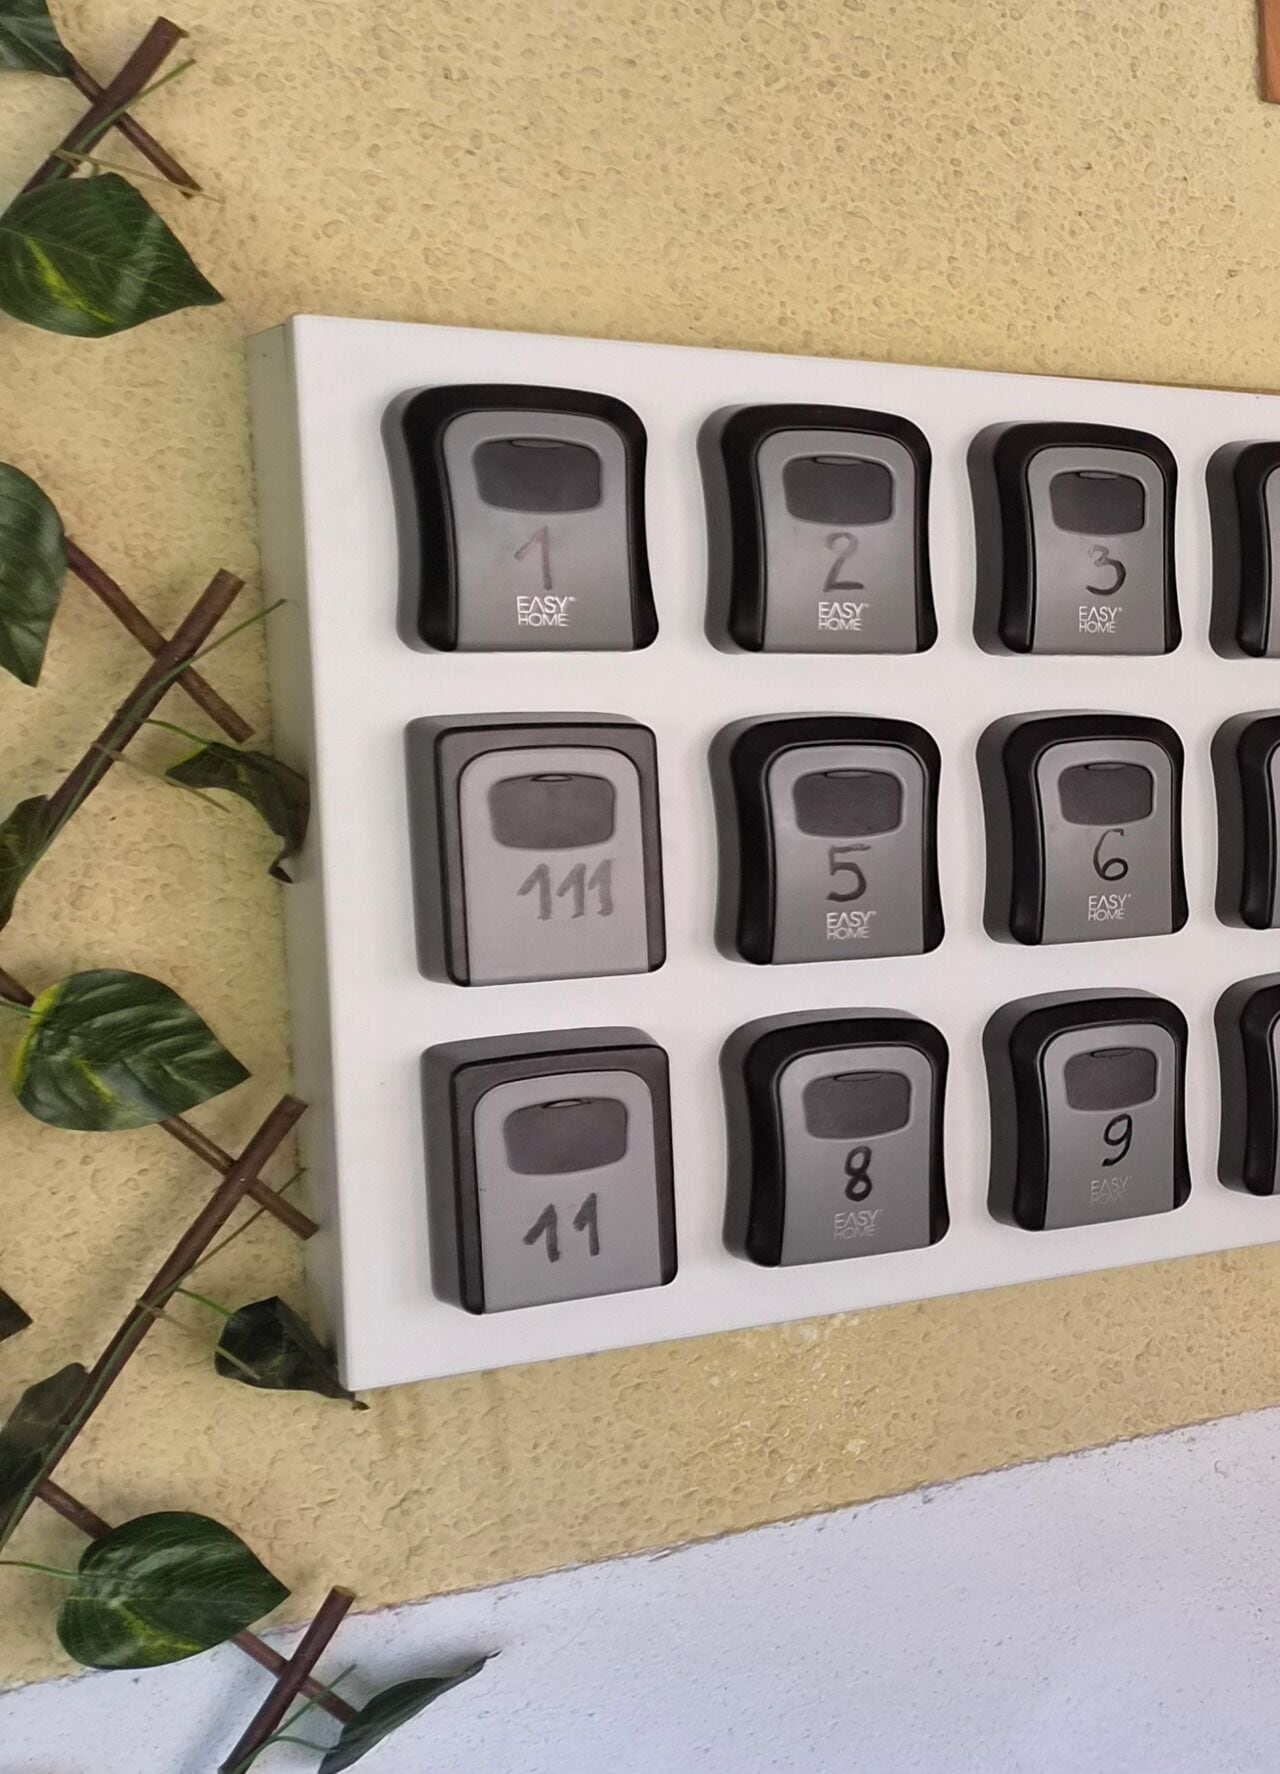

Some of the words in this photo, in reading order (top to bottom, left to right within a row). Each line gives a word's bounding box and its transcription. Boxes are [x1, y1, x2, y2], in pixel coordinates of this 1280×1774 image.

[514, 525, 552, 591] 1
[822, 531, 865, 592] 2
[1086, 545, 1127, 596] 3
[516, 595, 570, 613] EASY
[818, 601, 863, 617] EASY
[517, 613, 569, 627] HOME
[1078, 605, 1118, 622] EASY
[818, 616, 862, 631] HOME
[1078, 621, 1117, 634] HOME
[1093, 828, 1128, 881] 6
[826, 844, 872, 902] 5
[516, 857, 616, 920] 111
[1087, 895, 1127, 910] EASY
[825, 912, 872, 928] EASY
[1087, 909, 1126, 921] HOME
[825, 927, 871, 940] HOME
[1102, 1113, 1133, 1168] 9
[845, 1145, 873, 1202] 8
[522, 1192, 600, 1263] 11
